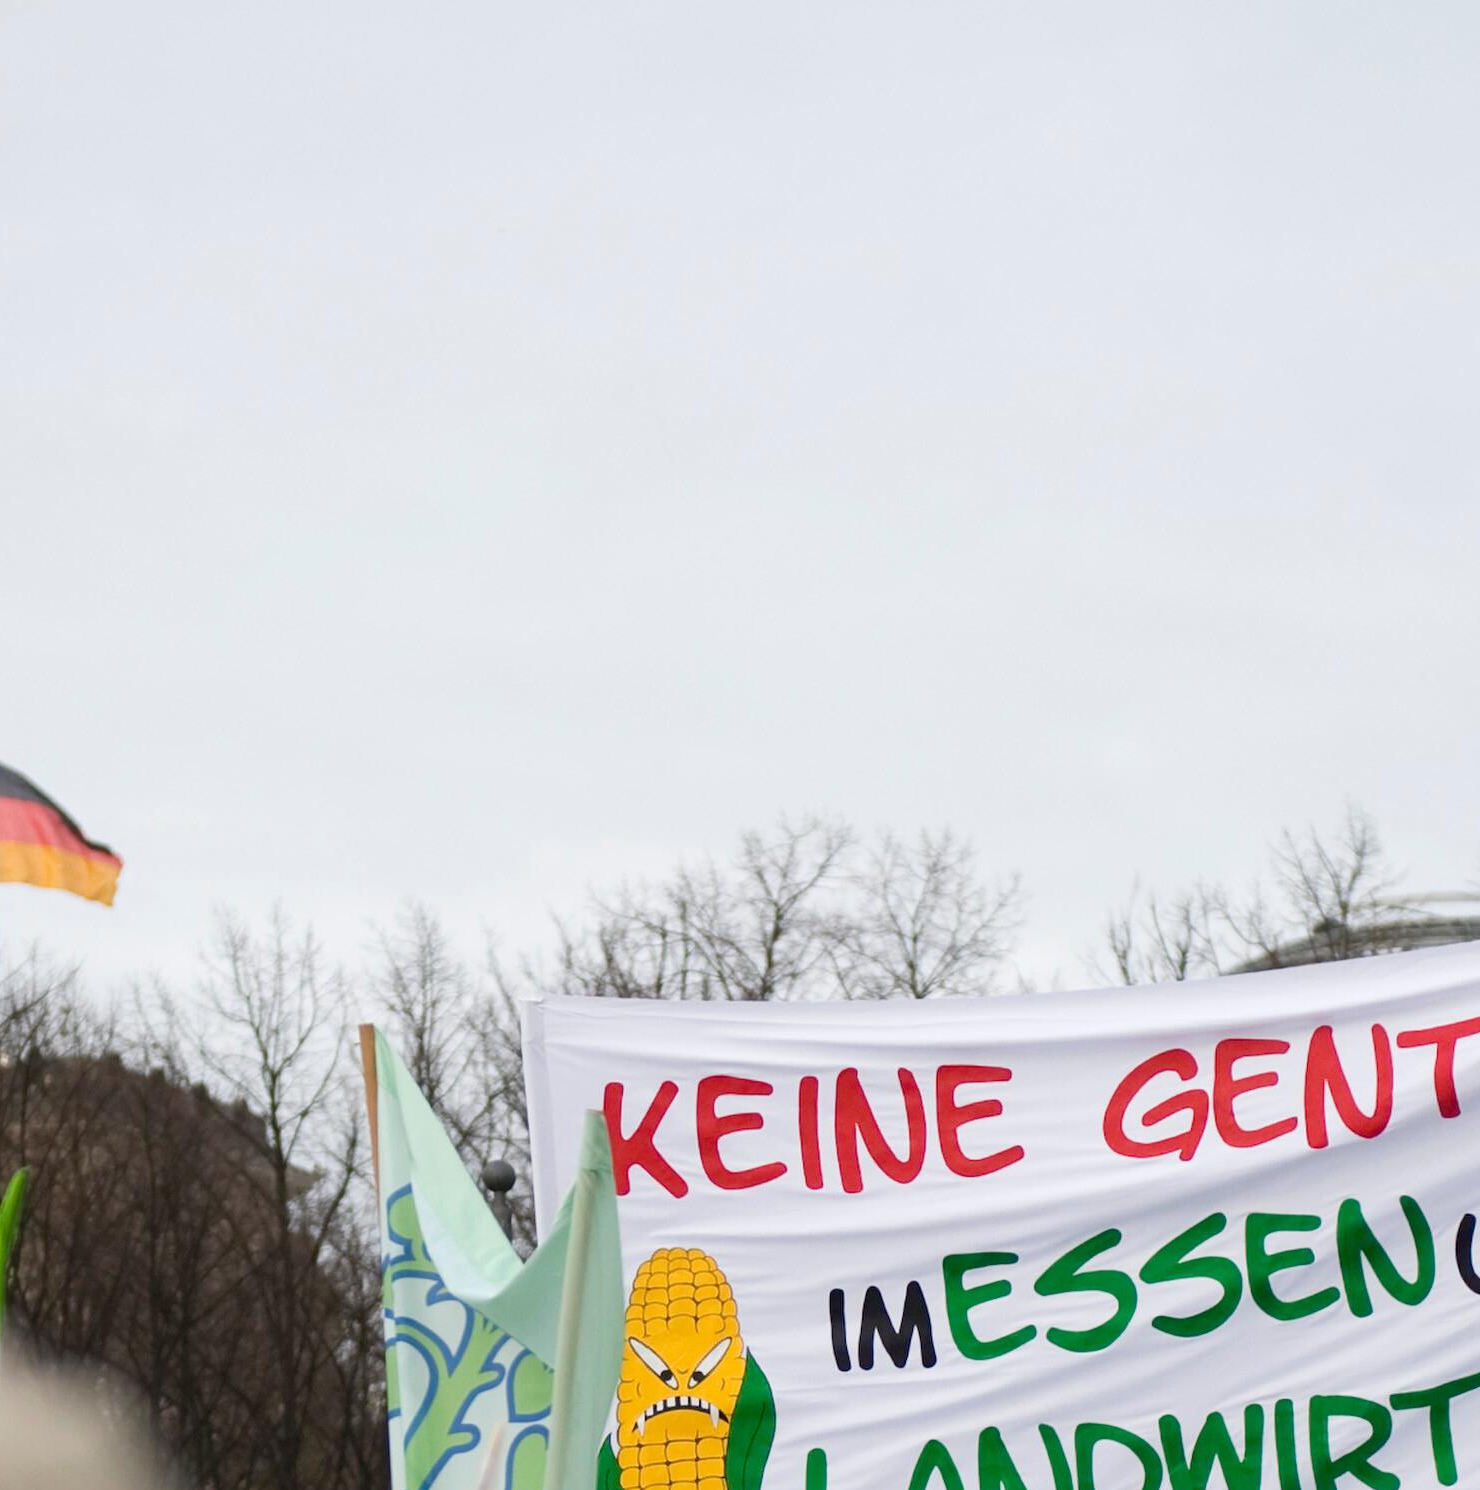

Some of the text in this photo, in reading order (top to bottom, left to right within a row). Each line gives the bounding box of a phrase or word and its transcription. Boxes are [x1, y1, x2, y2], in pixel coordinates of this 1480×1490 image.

[602, 1065, 1025, 1199] KEINE
[829, 1280, 937, 1372] IM
[942, 1195, 1436, 1361] ESSEN
